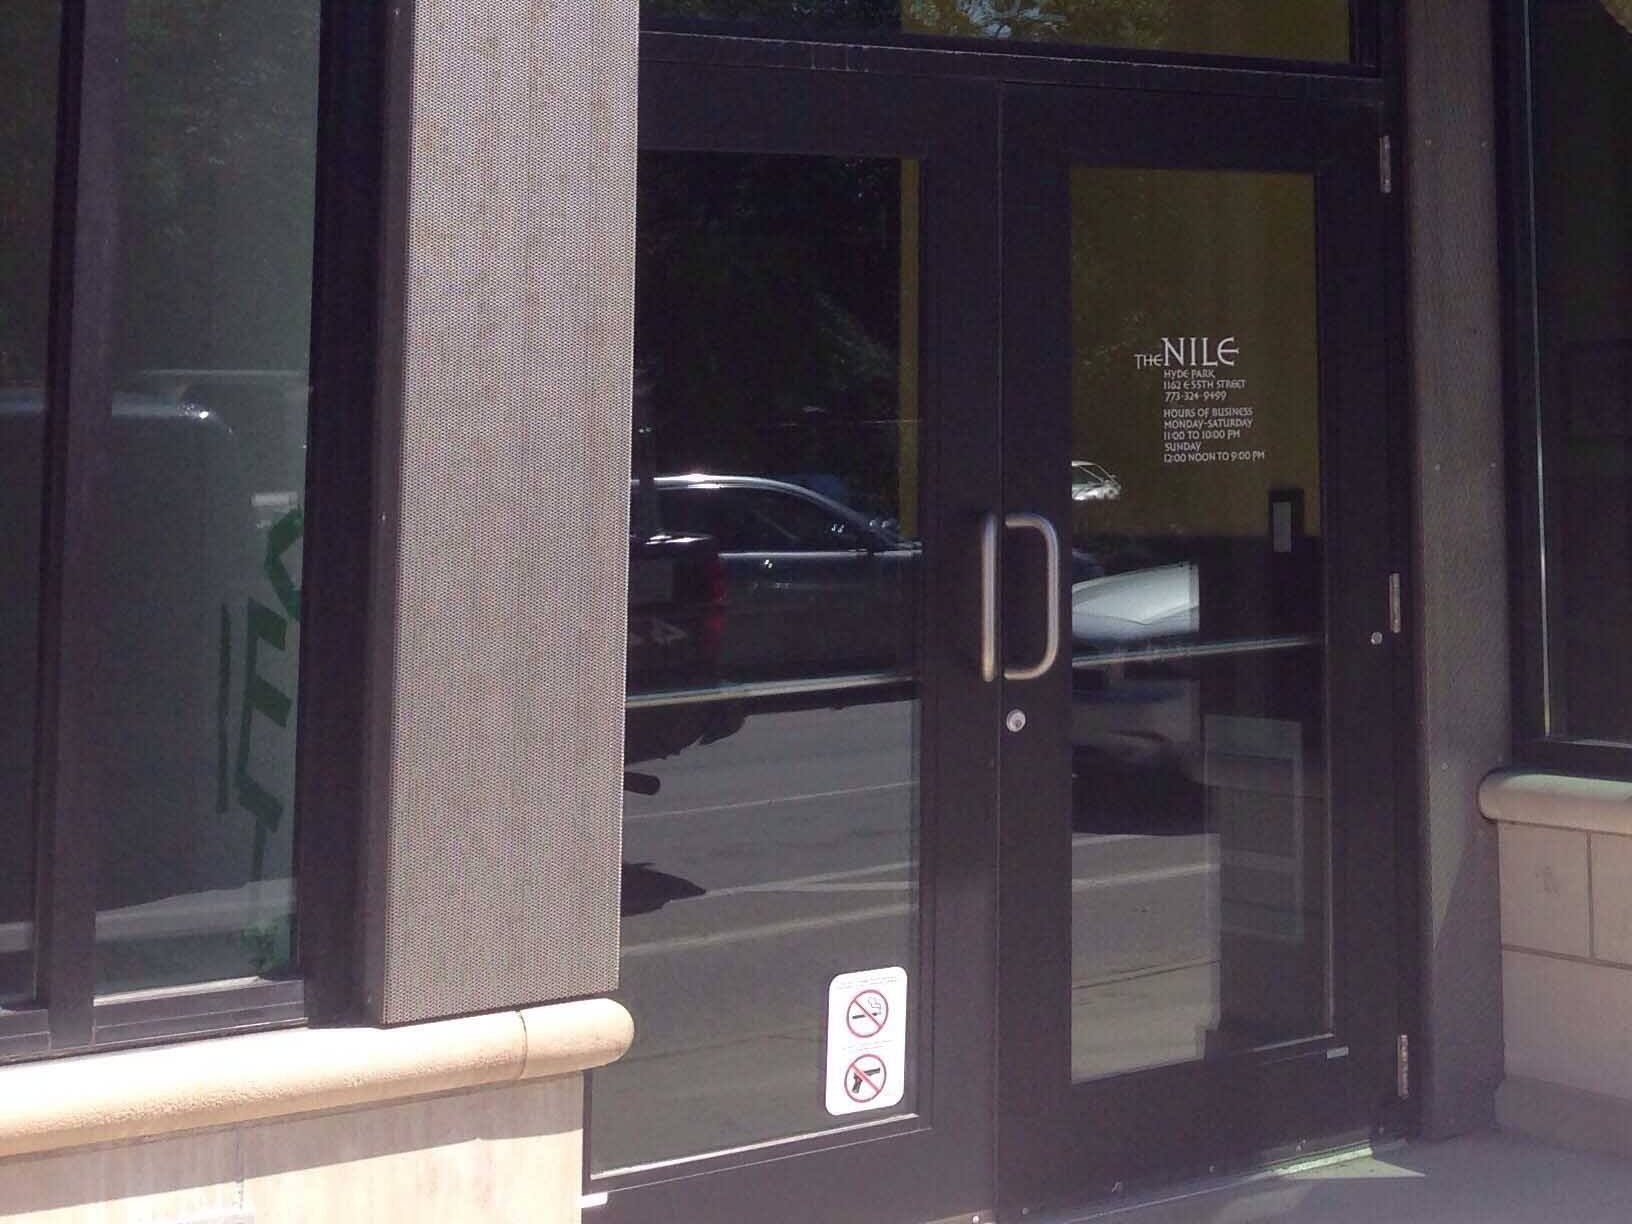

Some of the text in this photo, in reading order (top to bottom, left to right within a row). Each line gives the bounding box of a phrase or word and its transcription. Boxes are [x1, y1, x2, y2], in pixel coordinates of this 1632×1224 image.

[1134, 336, 1239, 370] THE NILE
[1163, 369, 1216, 380] HYDE PARK
[1163, 381, 1181, 391] 1162
[1216, 379, 1247, 389] STREET
[1163, 407, 1254, 419] HOURS OF BUSINESS
[1163, 418, 1254, 430] MONDAY-SATURDAY
[1188, 430, 1200, 440] TO
[1201, 430, 1226, 440] 10:00
[1227, 429, 1241, 440] PM
[1164, 441, 1202, 453] SUNDAY
[1163, 453, 1187, 464] 12:00
[1188, 452, 1216, 463] NOON
[1217, 451, 1230, 462] TO
[1252, 450, 1265, 462] PM
